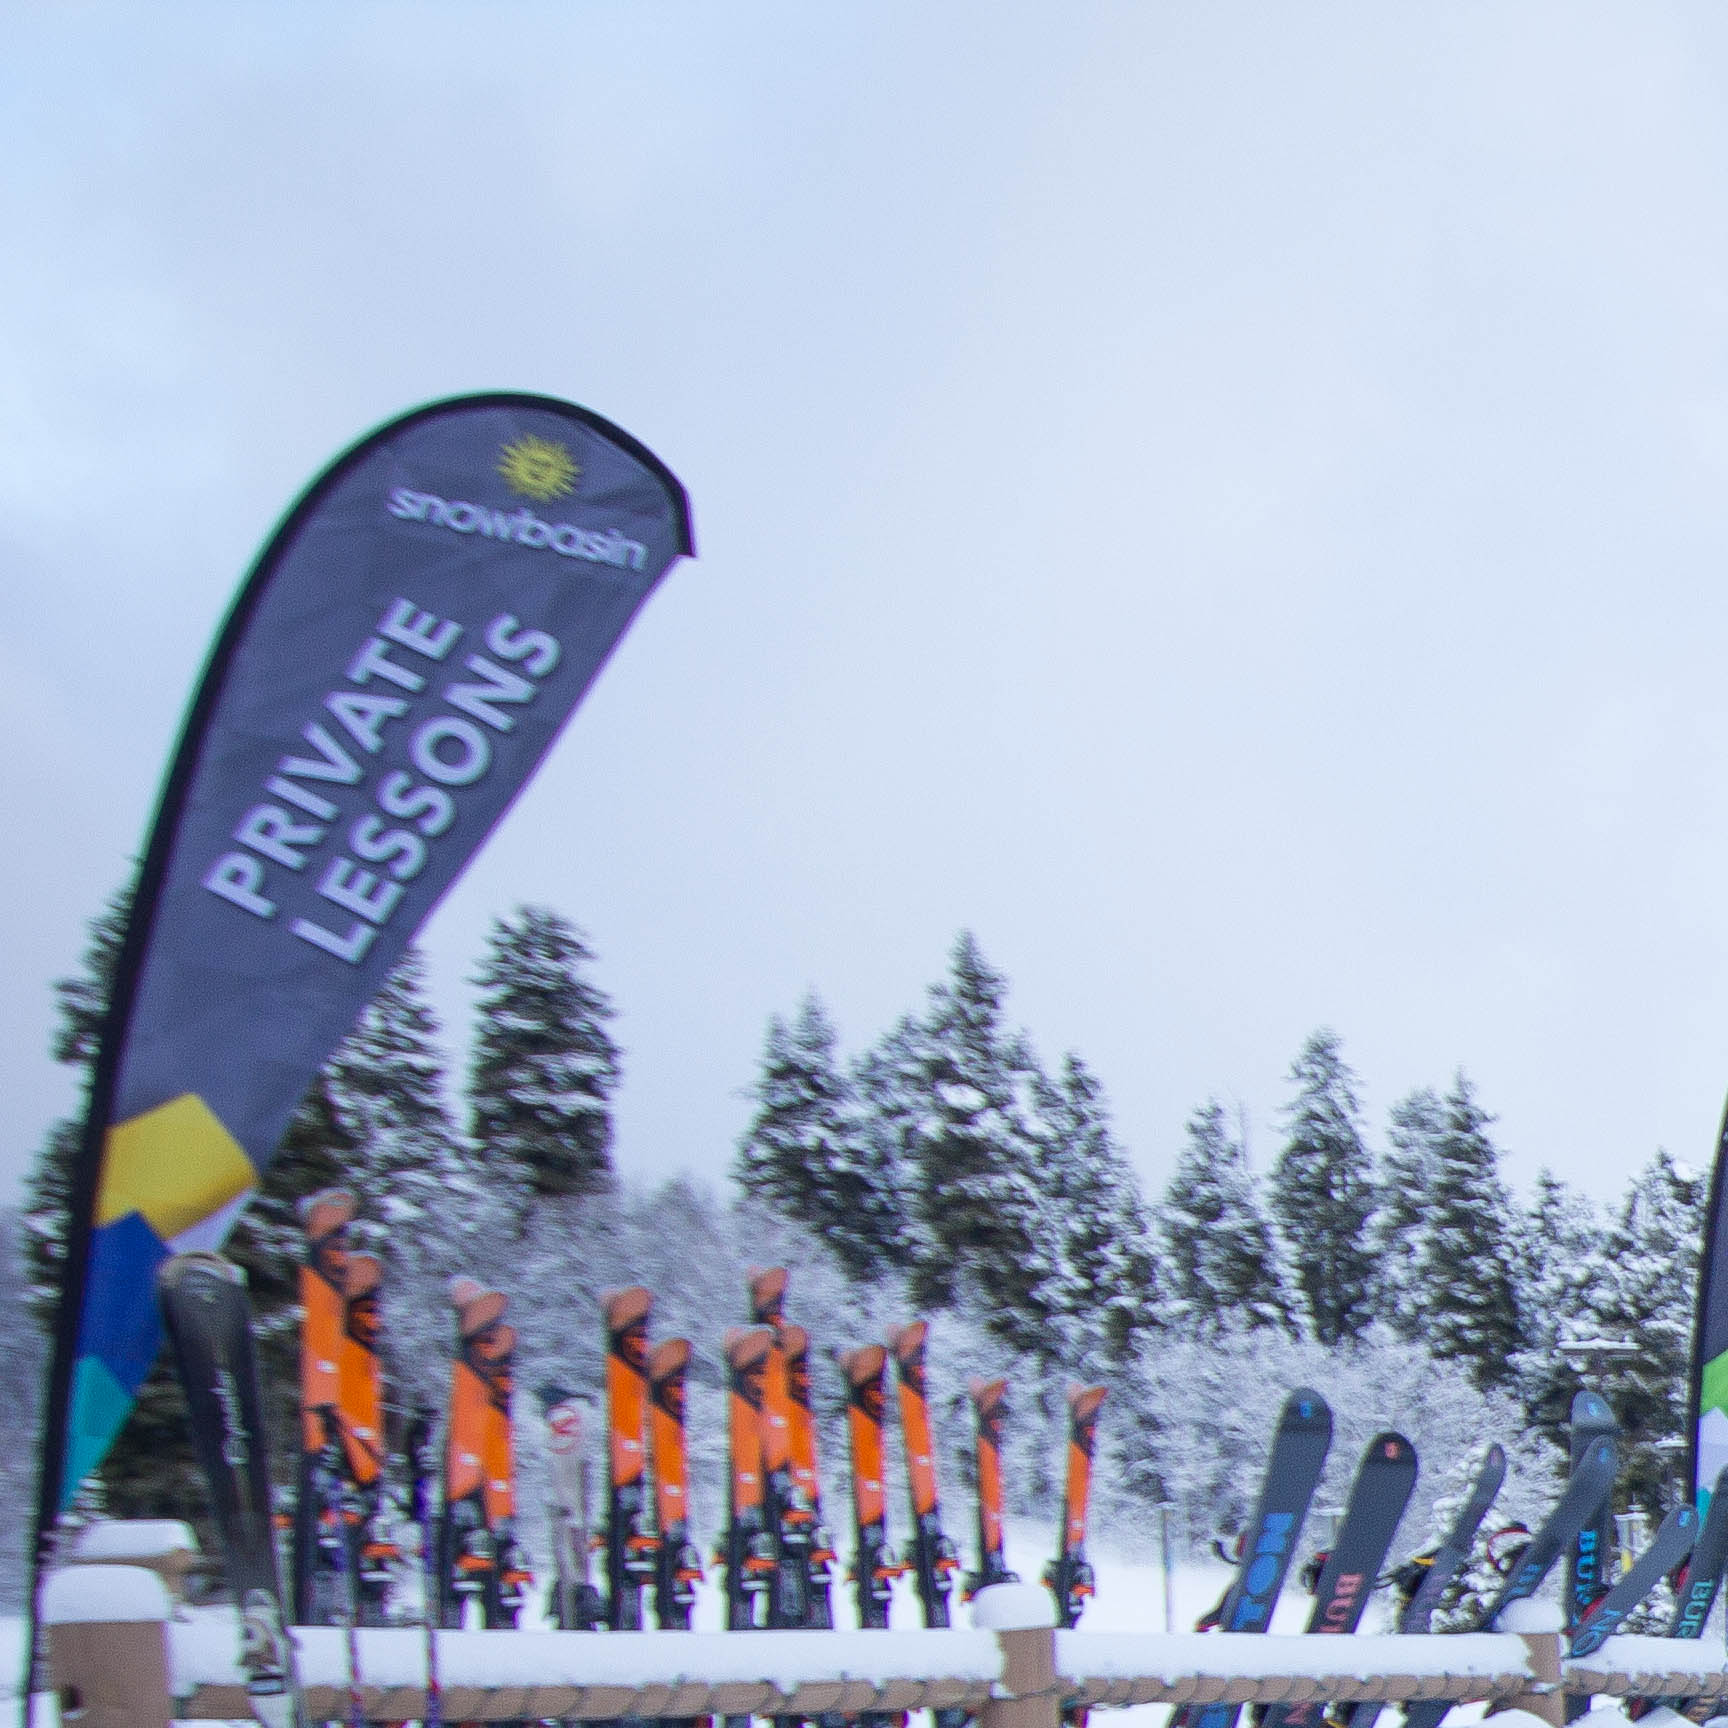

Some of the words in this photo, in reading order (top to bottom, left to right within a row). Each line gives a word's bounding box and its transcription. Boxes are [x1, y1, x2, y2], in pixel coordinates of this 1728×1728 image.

[389, 486, 648, 571] snowbasin
[202, 597, 464, 920] PRIVATE
[289, 612, 563, 965] LESSONS
